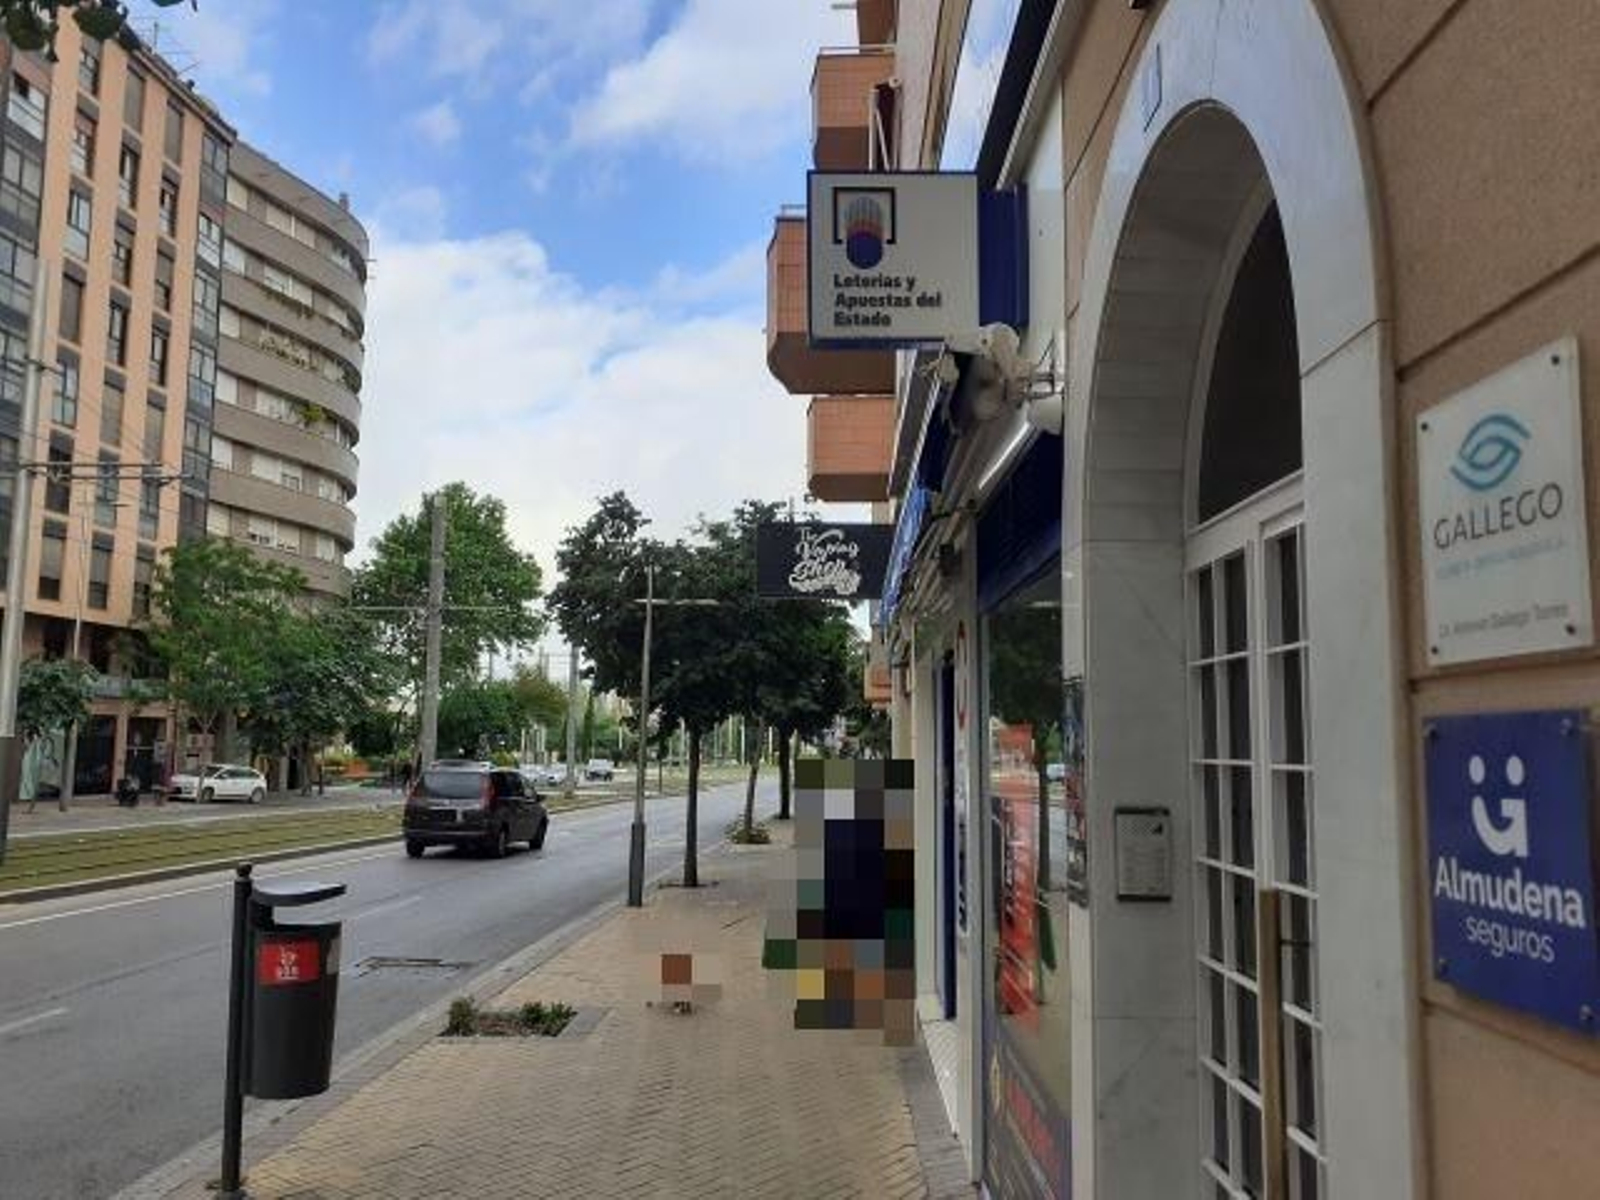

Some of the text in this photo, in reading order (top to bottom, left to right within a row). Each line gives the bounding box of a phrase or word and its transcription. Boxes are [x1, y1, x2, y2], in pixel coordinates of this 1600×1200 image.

[836, 291, 942, 310] Apuestas del
[906, 275, 916, 292] y
[834, 311, 891, 326] Estado
[1433, 482, 1564, 550] GALLEGO
[1434, 856, 1586, 929] Almudena
[1465, 914, 1556, 964] seguros
